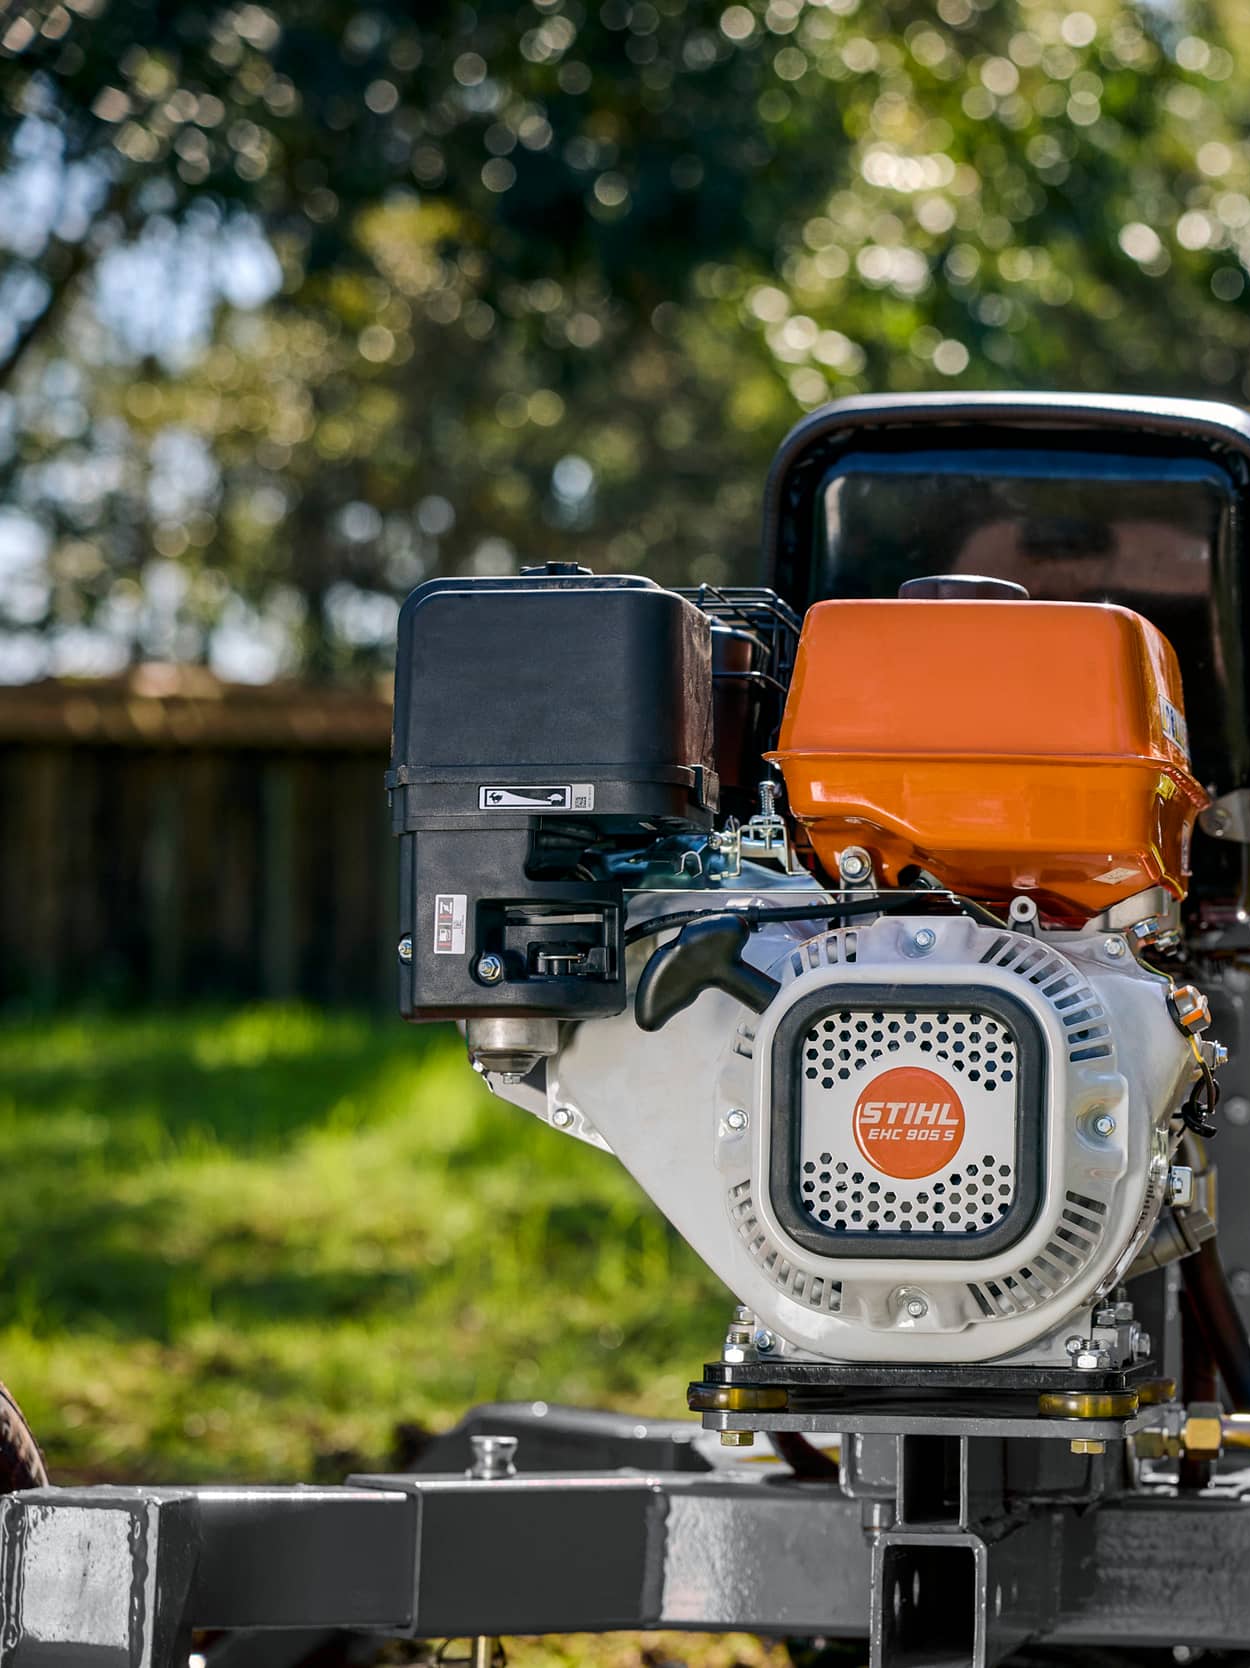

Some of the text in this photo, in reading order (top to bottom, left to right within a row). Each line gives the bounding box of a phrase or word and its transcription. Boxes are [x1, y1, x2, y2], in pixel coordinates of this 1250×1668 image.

[860, 1102, 960, 1125] STIHL
[868, 1128, 956, 1141] EHC 905 S
